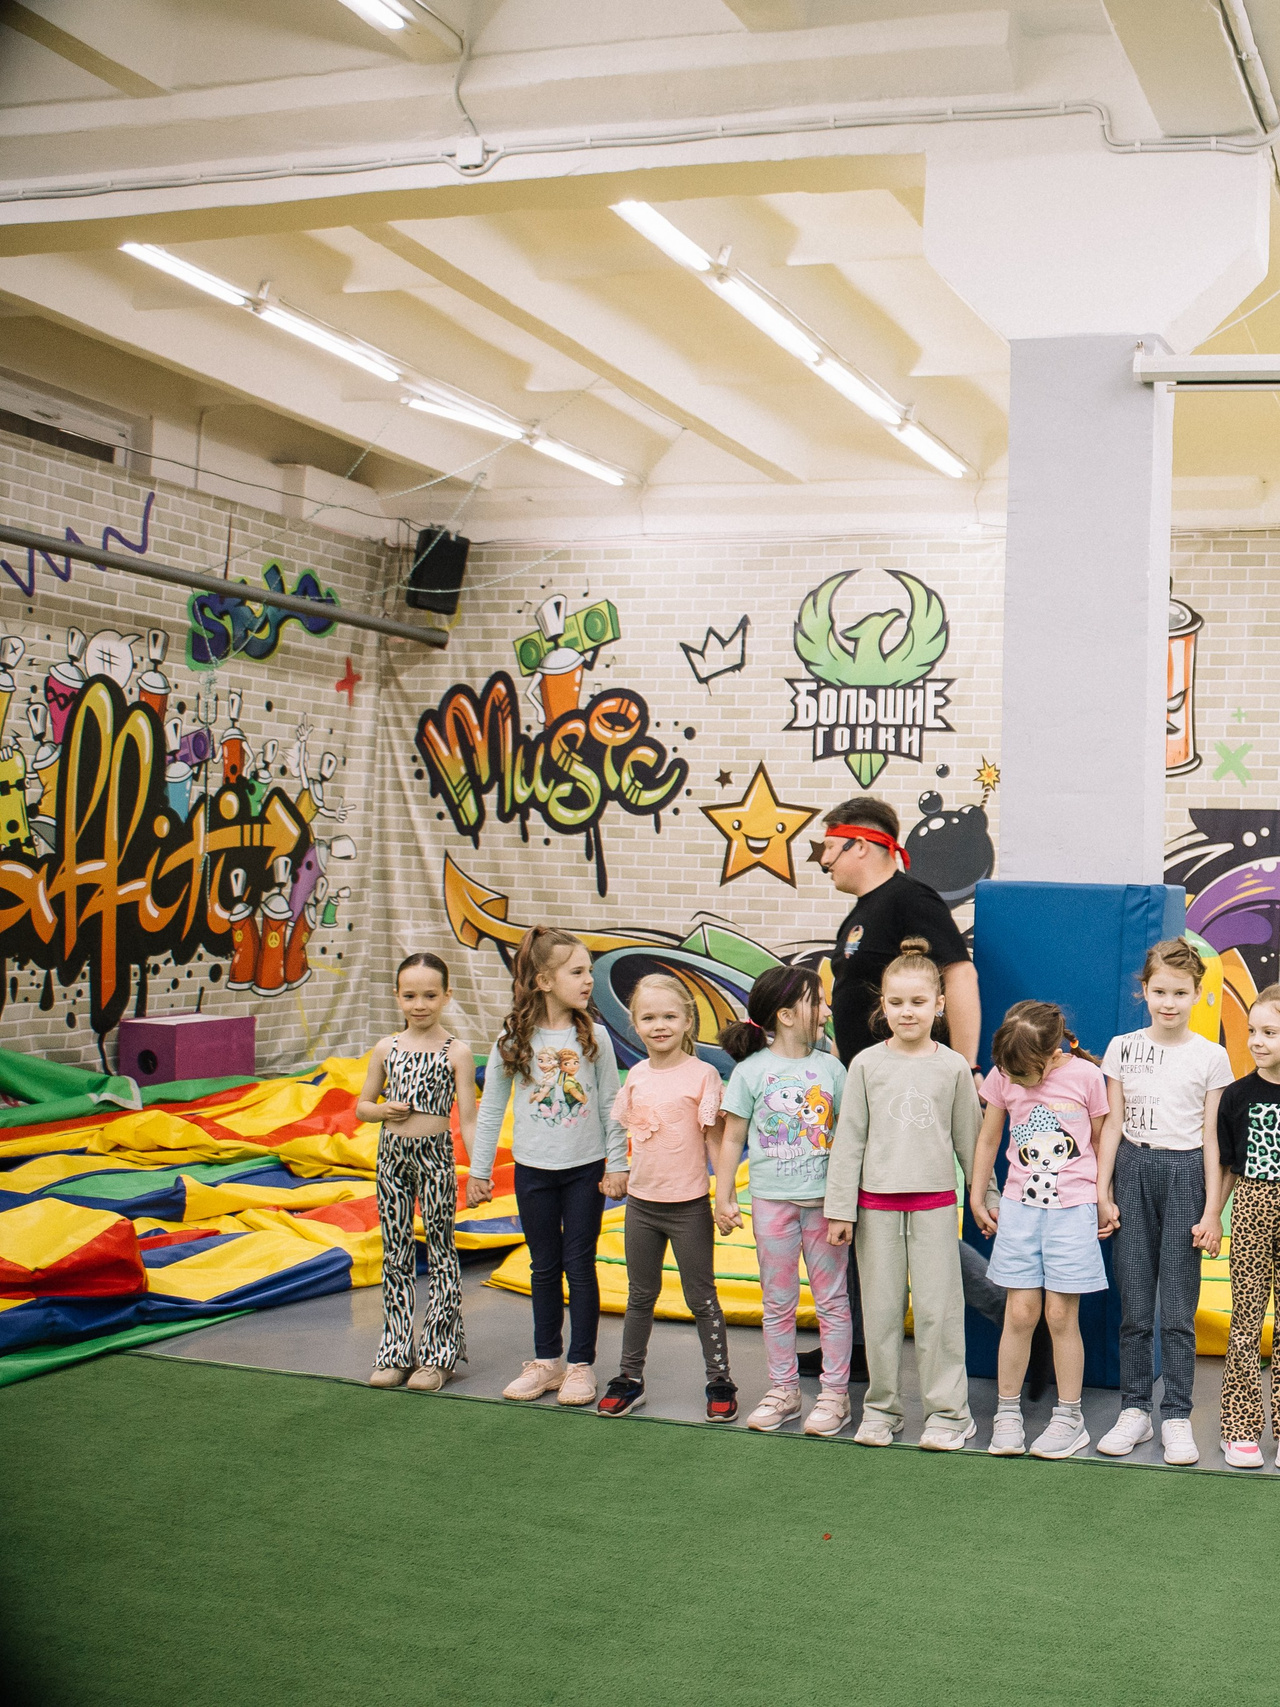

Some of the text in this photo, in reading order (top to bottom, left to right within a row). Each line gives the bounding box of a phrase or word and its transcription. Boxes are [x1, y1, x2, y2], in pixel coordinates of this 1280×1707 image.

[791, 681, 949, 728] БОЛЬШИЕ
[418, 674, 687, 832] Music
[816, 726, 920, 757] ГОНКИ
